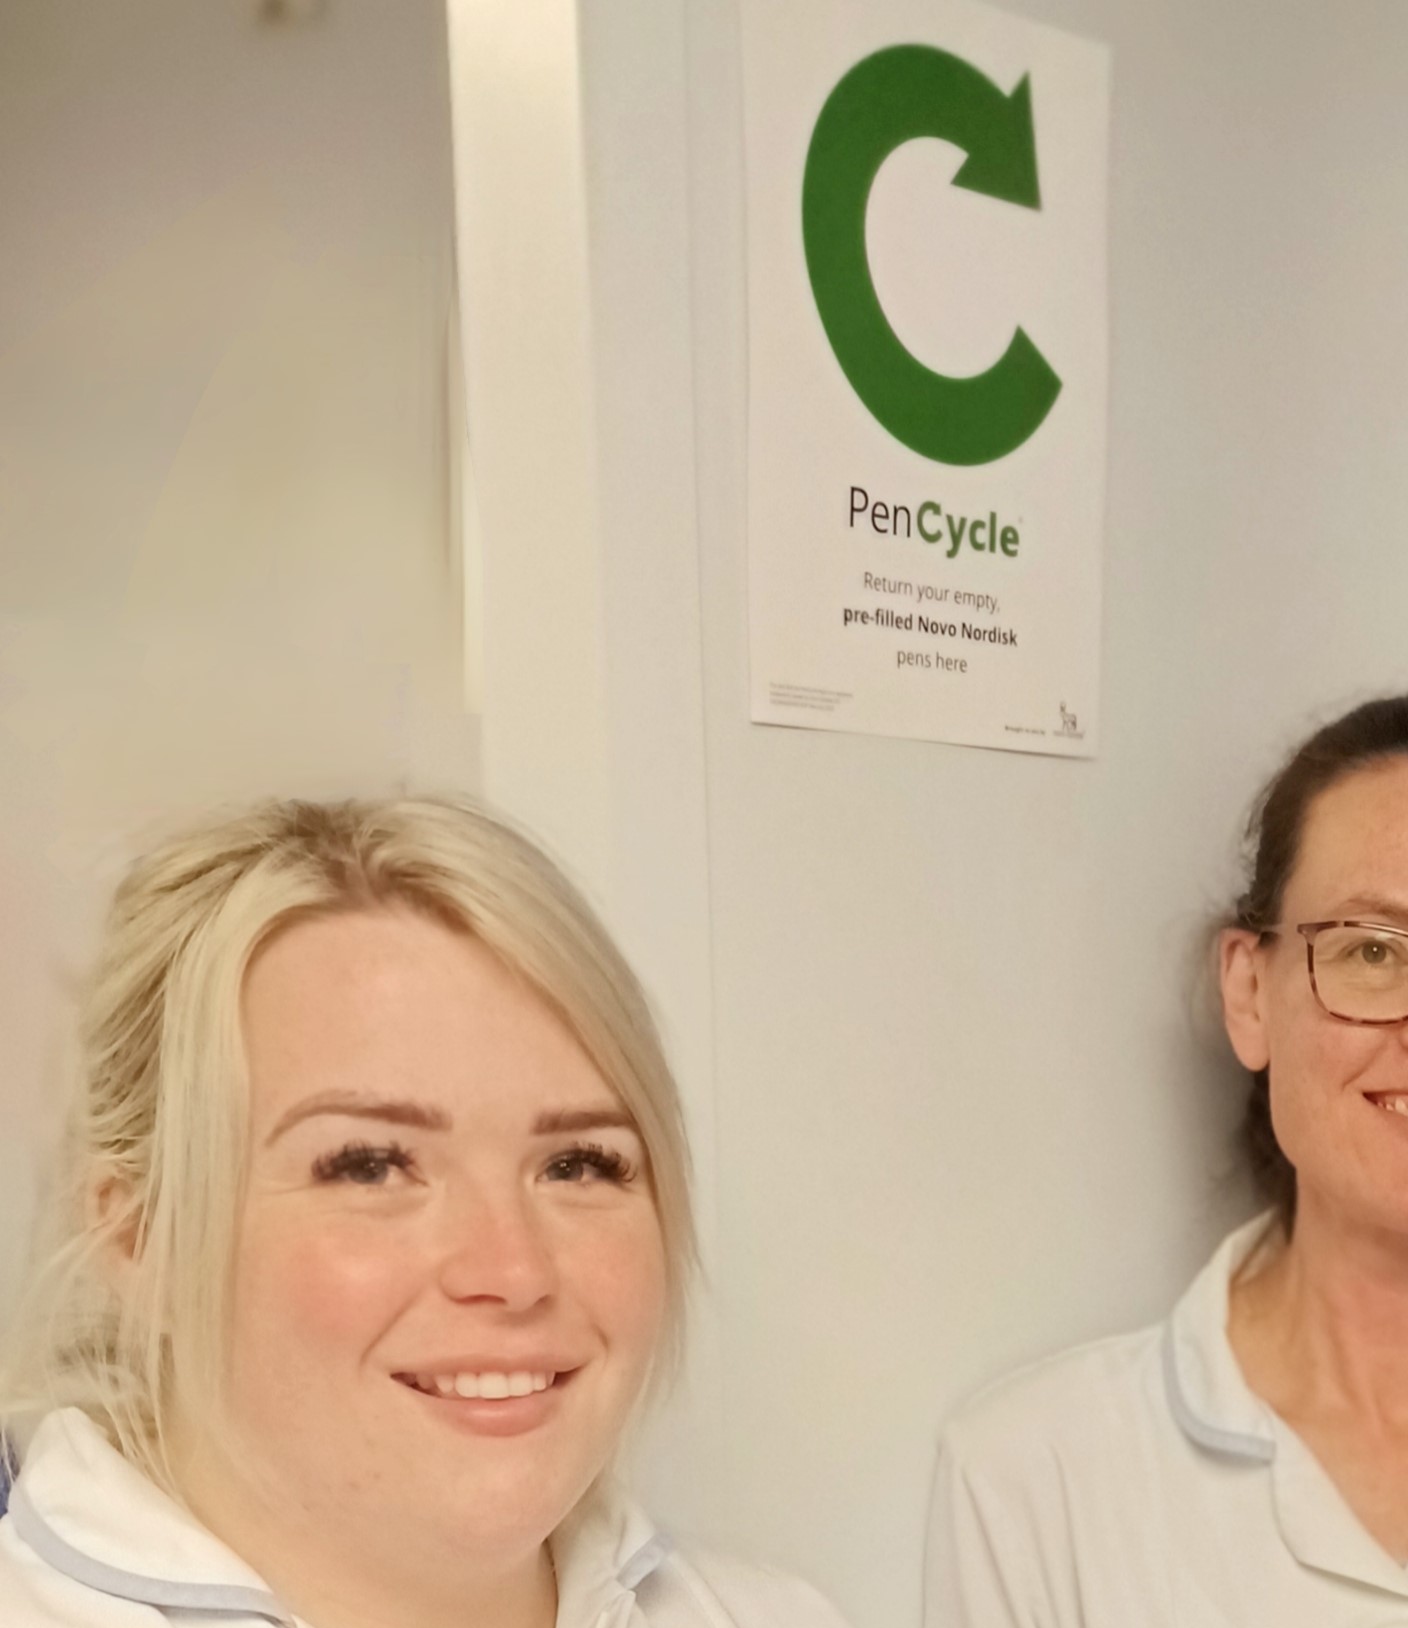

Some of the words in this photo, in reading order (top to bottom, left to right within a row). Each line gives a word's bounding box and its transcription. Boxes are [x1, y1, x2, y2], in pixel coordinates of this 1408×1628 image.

[850, 486, 1020, 558] PenCycle
[863, 571, 913, 596] Return
[916, 583, 950, 603] your
[953, 589, 1000, 615] empty,
[843, 607, 913, 630] pre-filled
[918, 615, 957, 637] Novo
[961, 622, 1018, 646] Nordisk
[897, 650, 932, 669] pens
[935, 651, 968, 673] here
